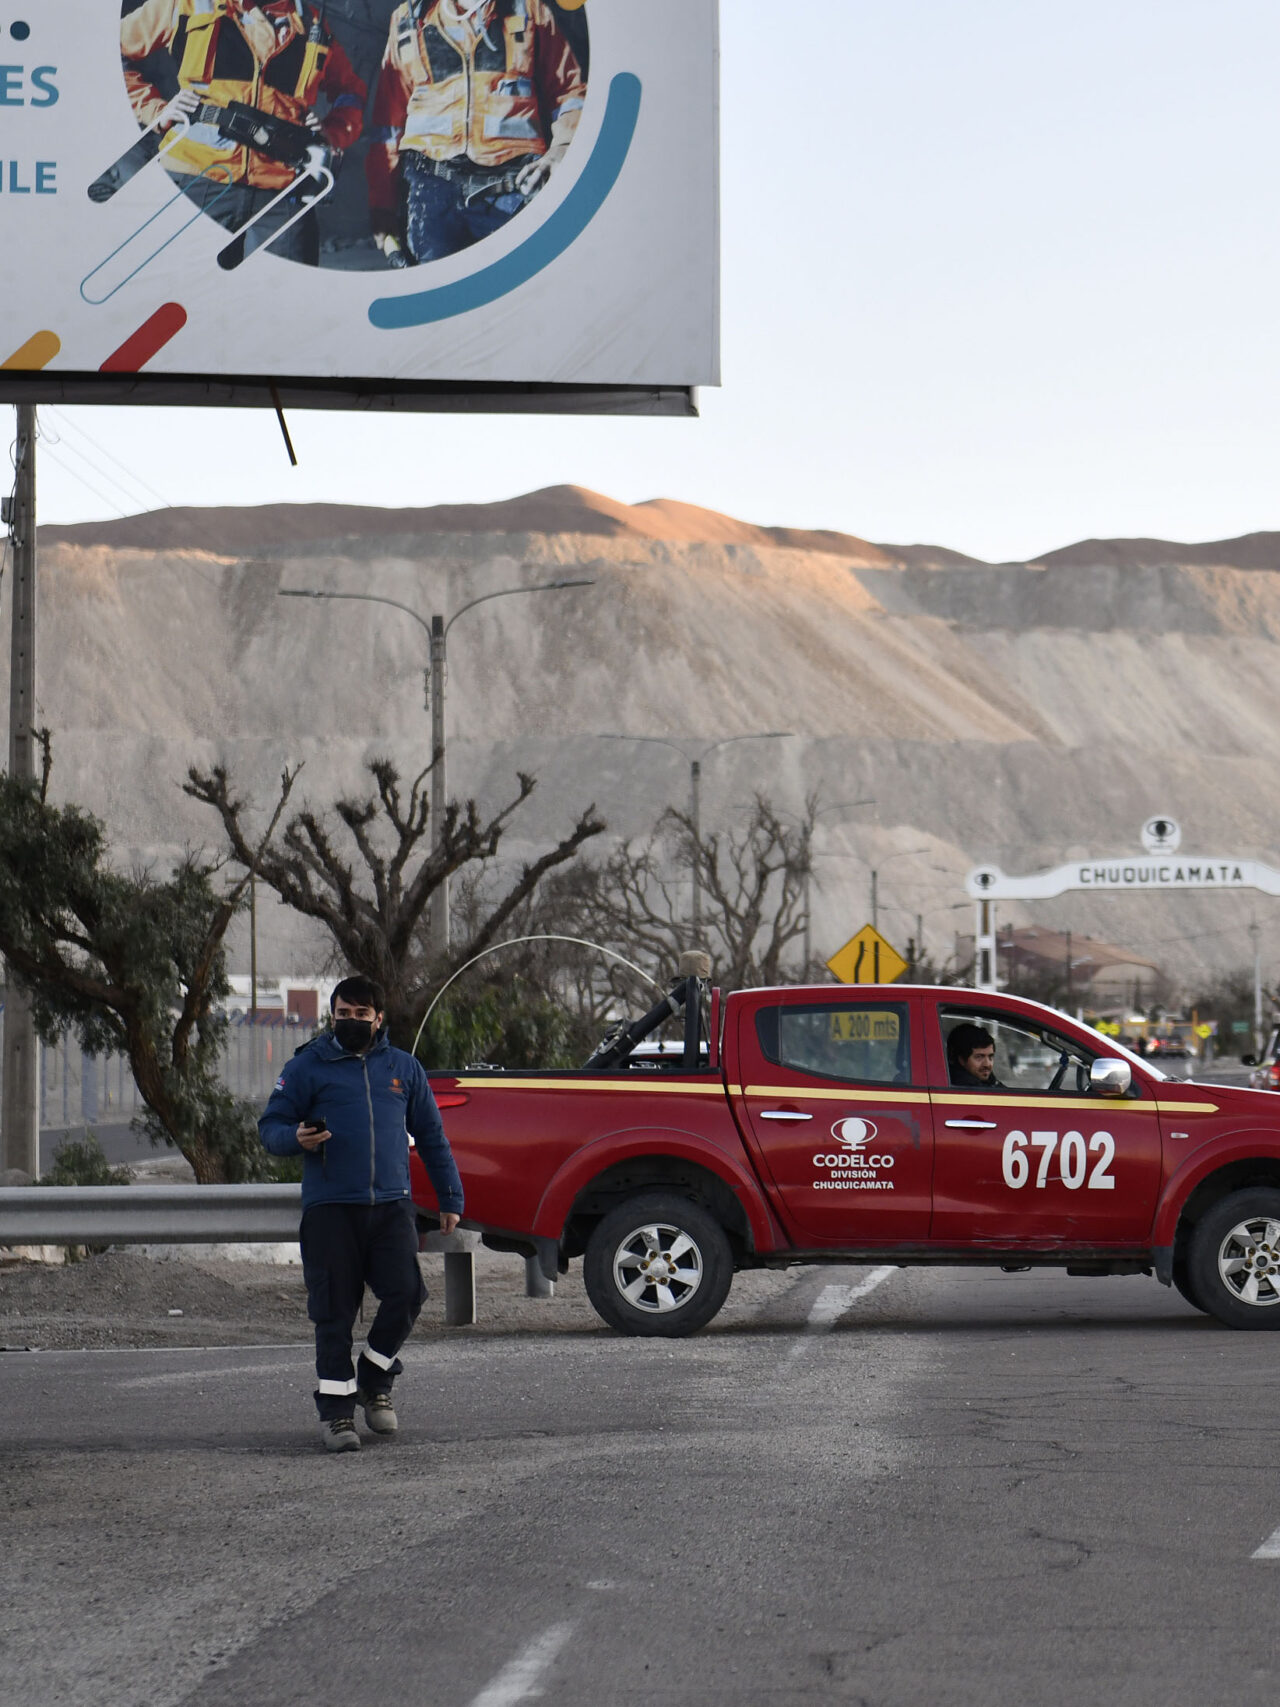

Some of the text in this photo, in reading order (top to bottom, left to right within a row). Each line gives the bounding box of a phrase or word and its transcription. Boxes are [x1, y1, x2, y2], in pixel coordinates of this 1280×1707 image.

[1079, 866, 1243, 884] CHUQUICAMATA
[833, 1014, 897, 1039] A 200 mts
[812, 1153, 895, 1169] CODELCO
[1002, 1130, 1115, 1190] 6702
[830, 1169, 877, 1179] DIVISIÓN
[812, 1181, 895, 1190] CHUQUICAMATA
